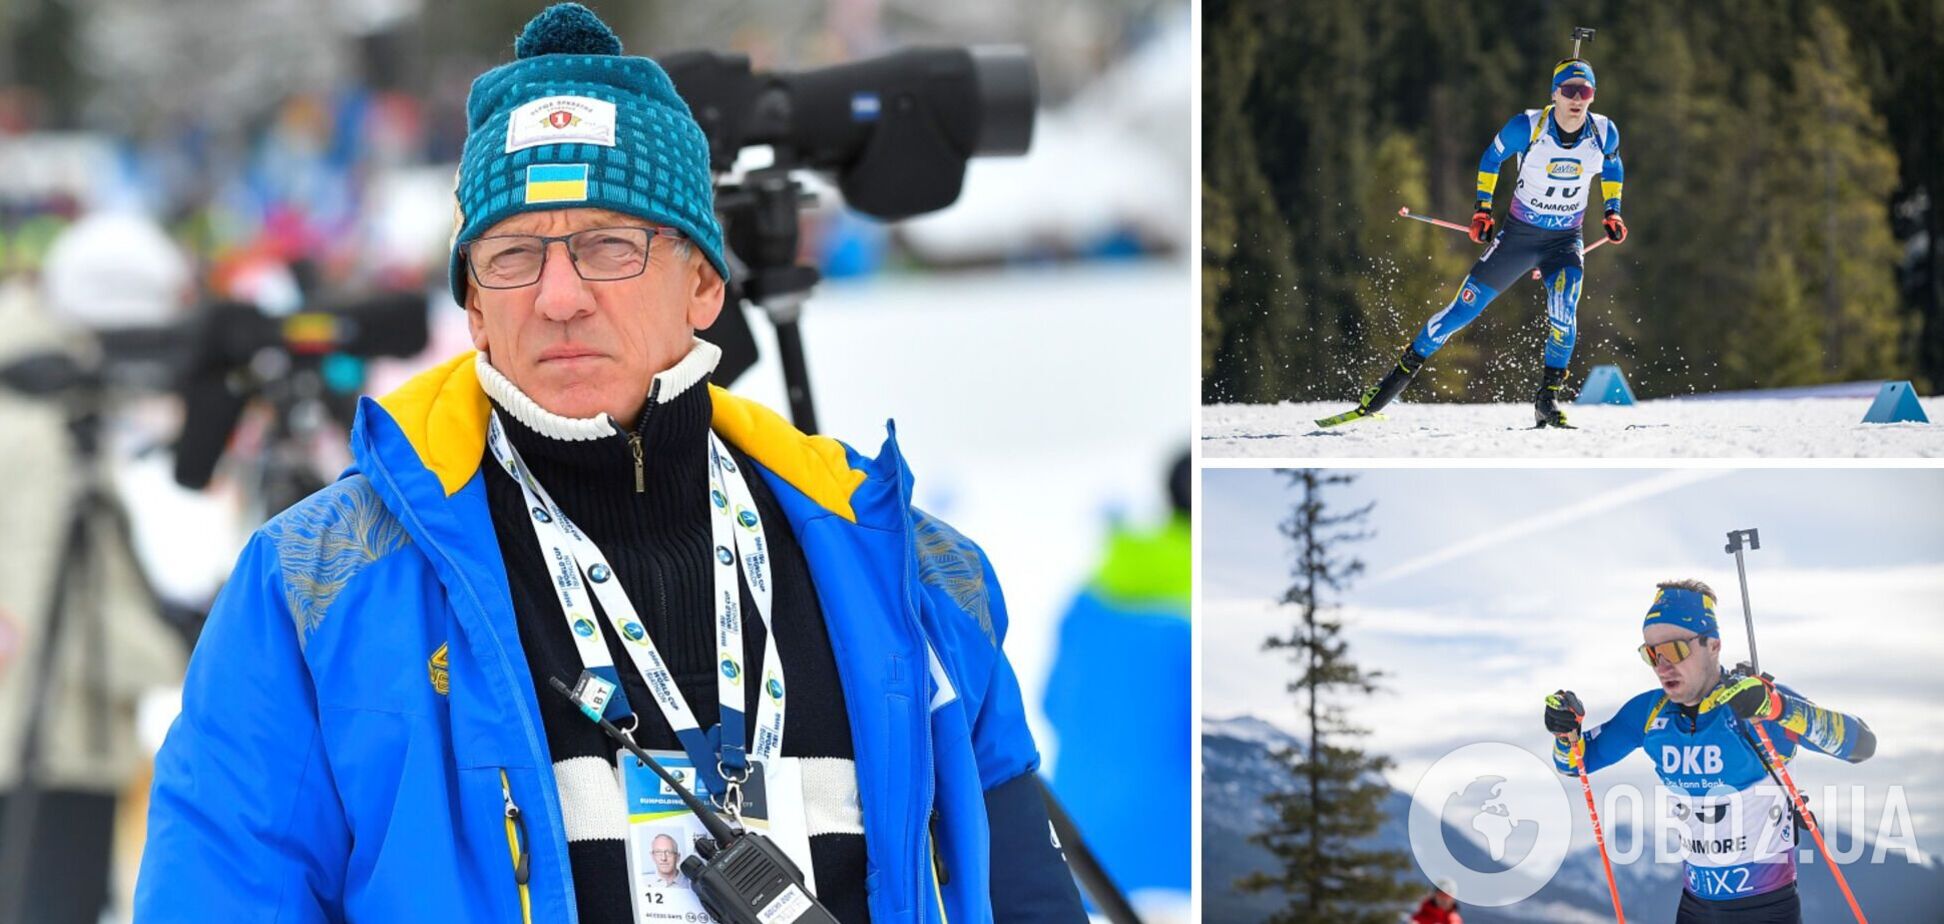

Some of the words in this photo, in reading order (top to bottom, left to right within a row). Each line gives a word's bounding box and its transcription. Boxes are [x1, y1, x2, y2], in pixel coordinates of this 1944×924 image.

[1552, 164, 1578, 174] LaVita
[553, 546, 563, 561] CUP
[653, 671, 670, 696] WORLD
[1662, 745, 1724, 775] DKB
[1678, 778, 1700, 789] kann
[1701, 778, 1725, 789] Bank
[1706, 867, 1754, 895] iX2
[645, 892, 664, 904] 12
